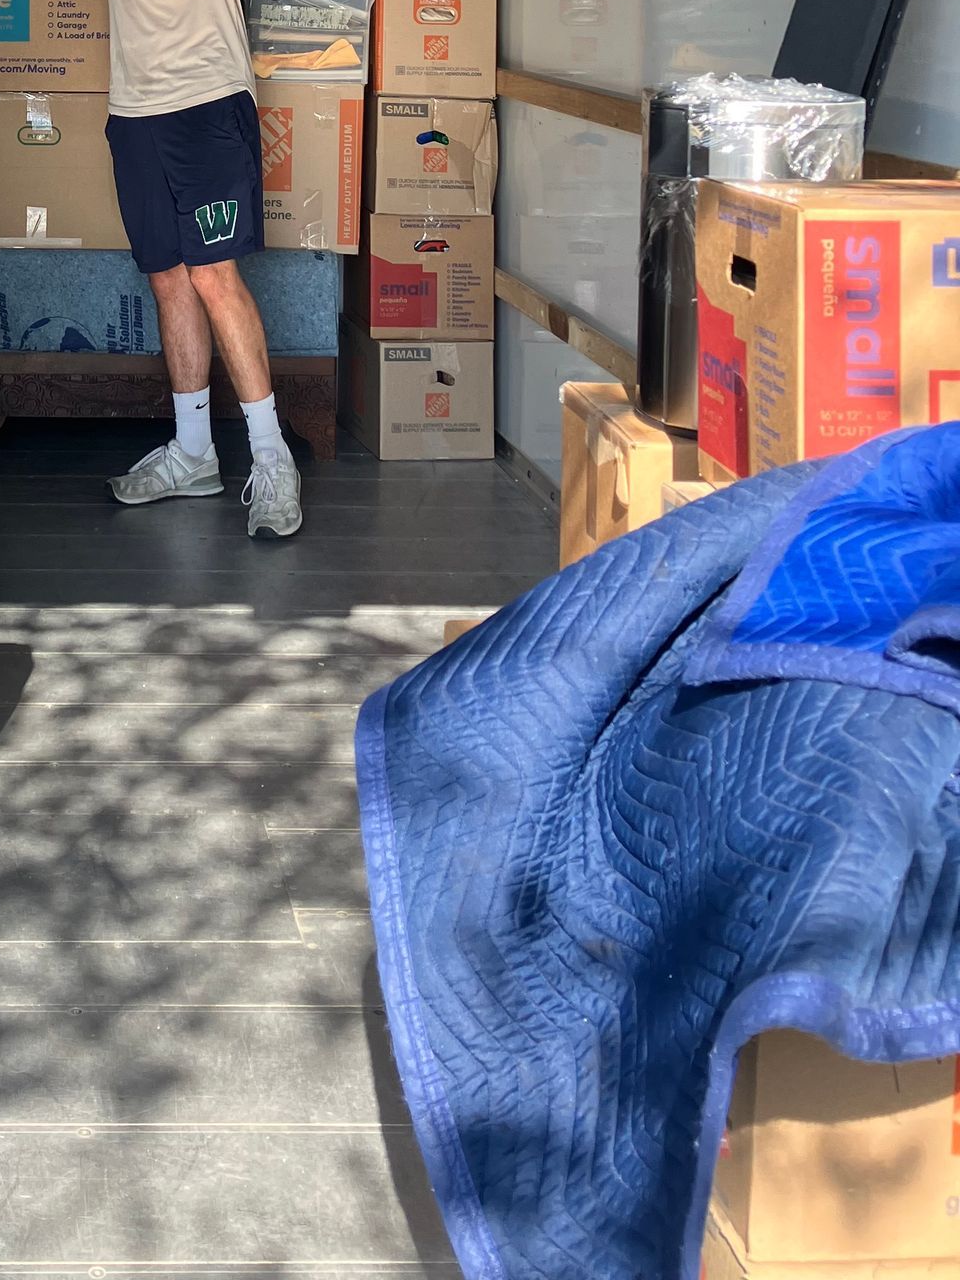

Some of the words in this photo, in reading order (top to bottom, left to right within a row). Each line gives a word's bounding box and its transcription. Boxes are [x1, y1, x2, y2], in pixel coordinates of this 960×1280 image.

[57, 11, 90, 19] Laundry
[57, 22, 87, 30] Garage
[385, 105, 424, 115] SMALL
[344, 124, 353, 174] MEDIUM
[344, 178, 352, 204] DUTY
[195, 200, 238, 245] W
[344, 211, 352, 239] HEAVY
[380, 282, 429, 297] small
[820, 239, 838, 318] pequeña
[119, 294, 129, 343] Solutions
[133, 295, 143, 327] Denim
[845, 236, 896, 397] small
[388, 350, 427, 359] SMALL
[819, 425, 836, 436] 1.3
[837, 425, 857, 436] CU
[858, 425, 874, 436] FT
